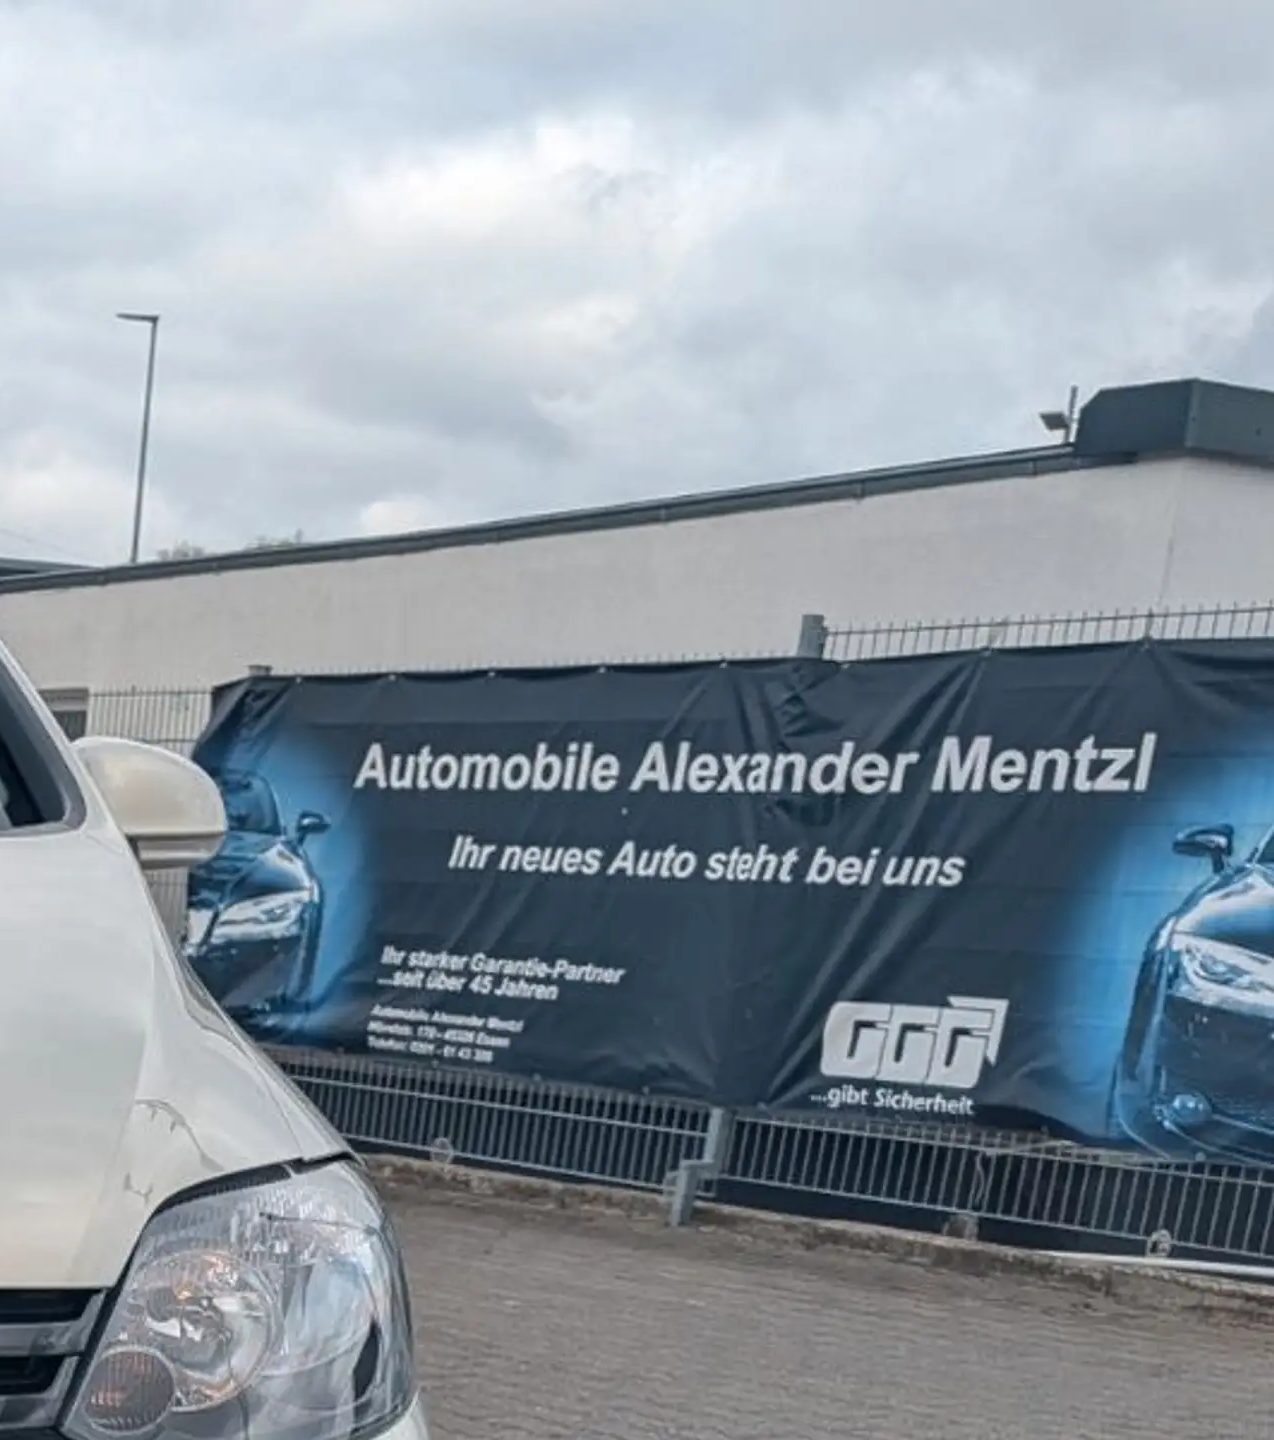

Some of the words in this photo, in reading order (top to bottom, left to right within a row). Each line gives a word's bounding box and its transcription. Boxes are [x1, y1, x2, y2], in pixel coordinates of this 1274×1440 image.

[353, 742, 620, 793] Automobile
[631, 741, 919, 794] Alexander
[931, 733, 1158, 794] Mentzl
[449, 834, 495, 870] Ihr
[499, 845, 602, 876] neues
[607, 841, 698, 881] Auto
[704, 843, 799, 884] steht
[805, 846, 878, 887] bei
[882, 854, 966, 888] uns
[381, 945, 406, 965] Ihr
[408, 951, 468, 971] starker
[470, 953, 626, 985] Garantie-Partner
[425, 972, 467, 992] über
[469, 974, 494, 995] 45
[494, 978, 559, 1001] Jahren
[821, 1001, 994, 1088] GGG
[873, 1088, 974, 1115] Sicherheit
